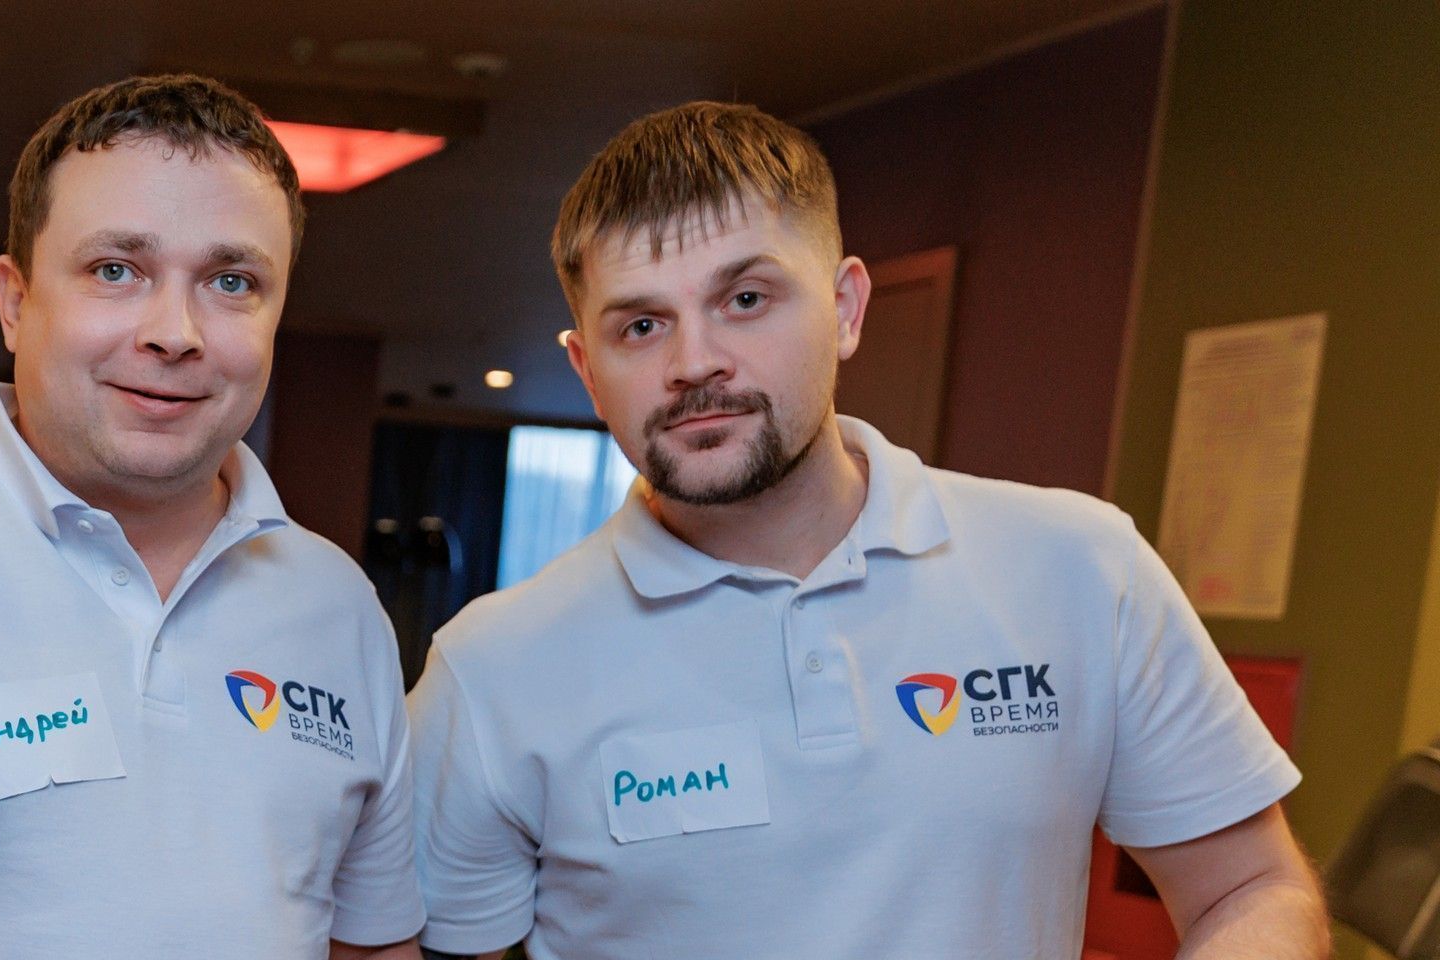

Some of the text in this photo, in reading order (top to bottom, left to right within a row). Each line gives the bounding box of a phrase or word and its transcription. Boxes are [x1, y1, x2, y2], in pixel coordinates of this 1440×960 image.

[963, 664, 1056, 701] СГК
[282, 681, 350, 730] СГК
[971, 701, 1059, 724] ВРЕМЯ
[288, 713, 353, 751] ВРЕМЯ
[973, 722, 1059, 736] БЕЗОПАСНОСТИ
